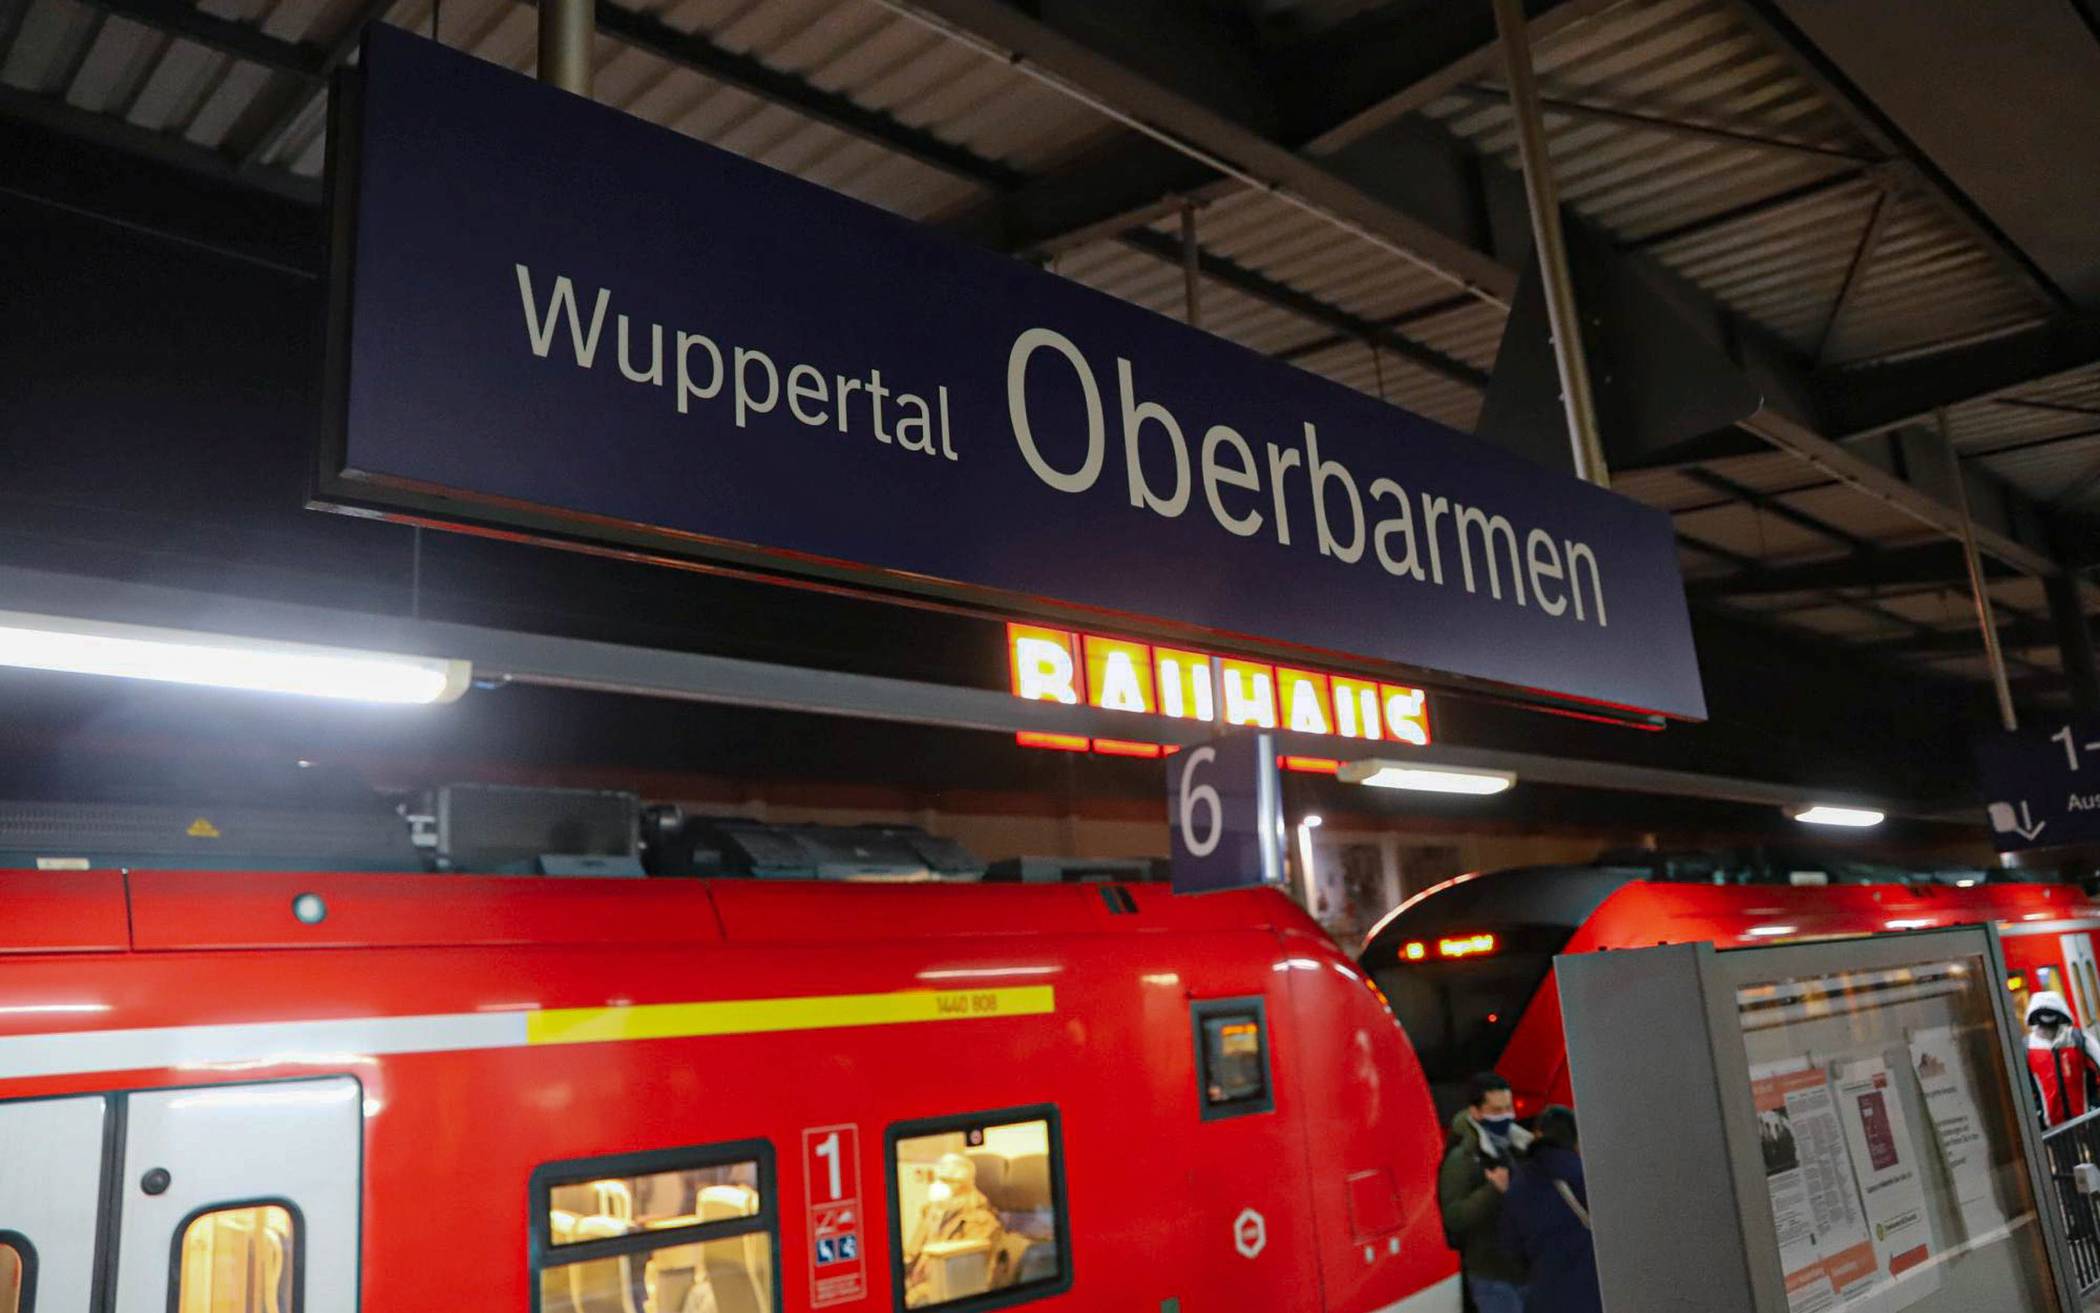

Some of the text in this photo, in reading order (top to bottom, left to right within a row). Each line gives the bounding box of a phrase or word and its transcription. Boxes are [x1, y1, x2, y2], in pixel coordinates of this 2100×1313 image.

[515, 262, 1607, 628] Wuppertal Oberbarmen
[1179, 746, 1223, 858] 6
[815, 1131, 842, 1201] 1
